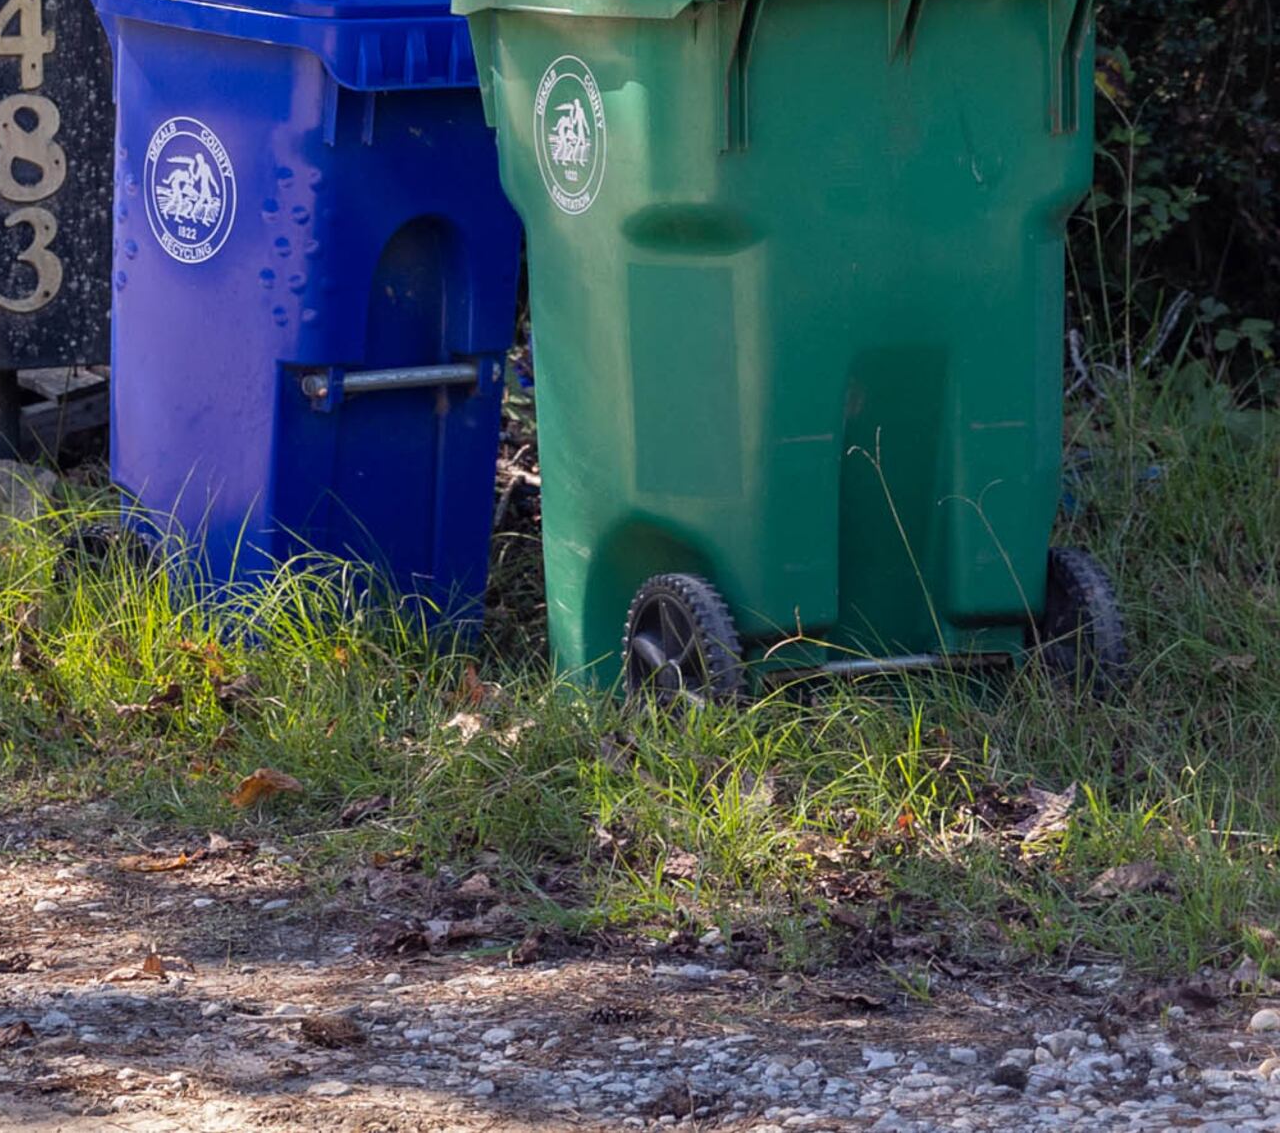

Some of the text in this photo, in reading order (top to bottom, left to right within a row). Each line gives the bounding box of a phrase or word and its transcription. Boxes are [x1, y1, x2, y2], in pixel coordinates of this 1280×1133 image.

[584, 74, 604, 129] COUNTY
[200, 129, 232, 178] COUNTY
[161, 233, 212, 260] RECYCLING
[178, 225, 197, 240] 1822
